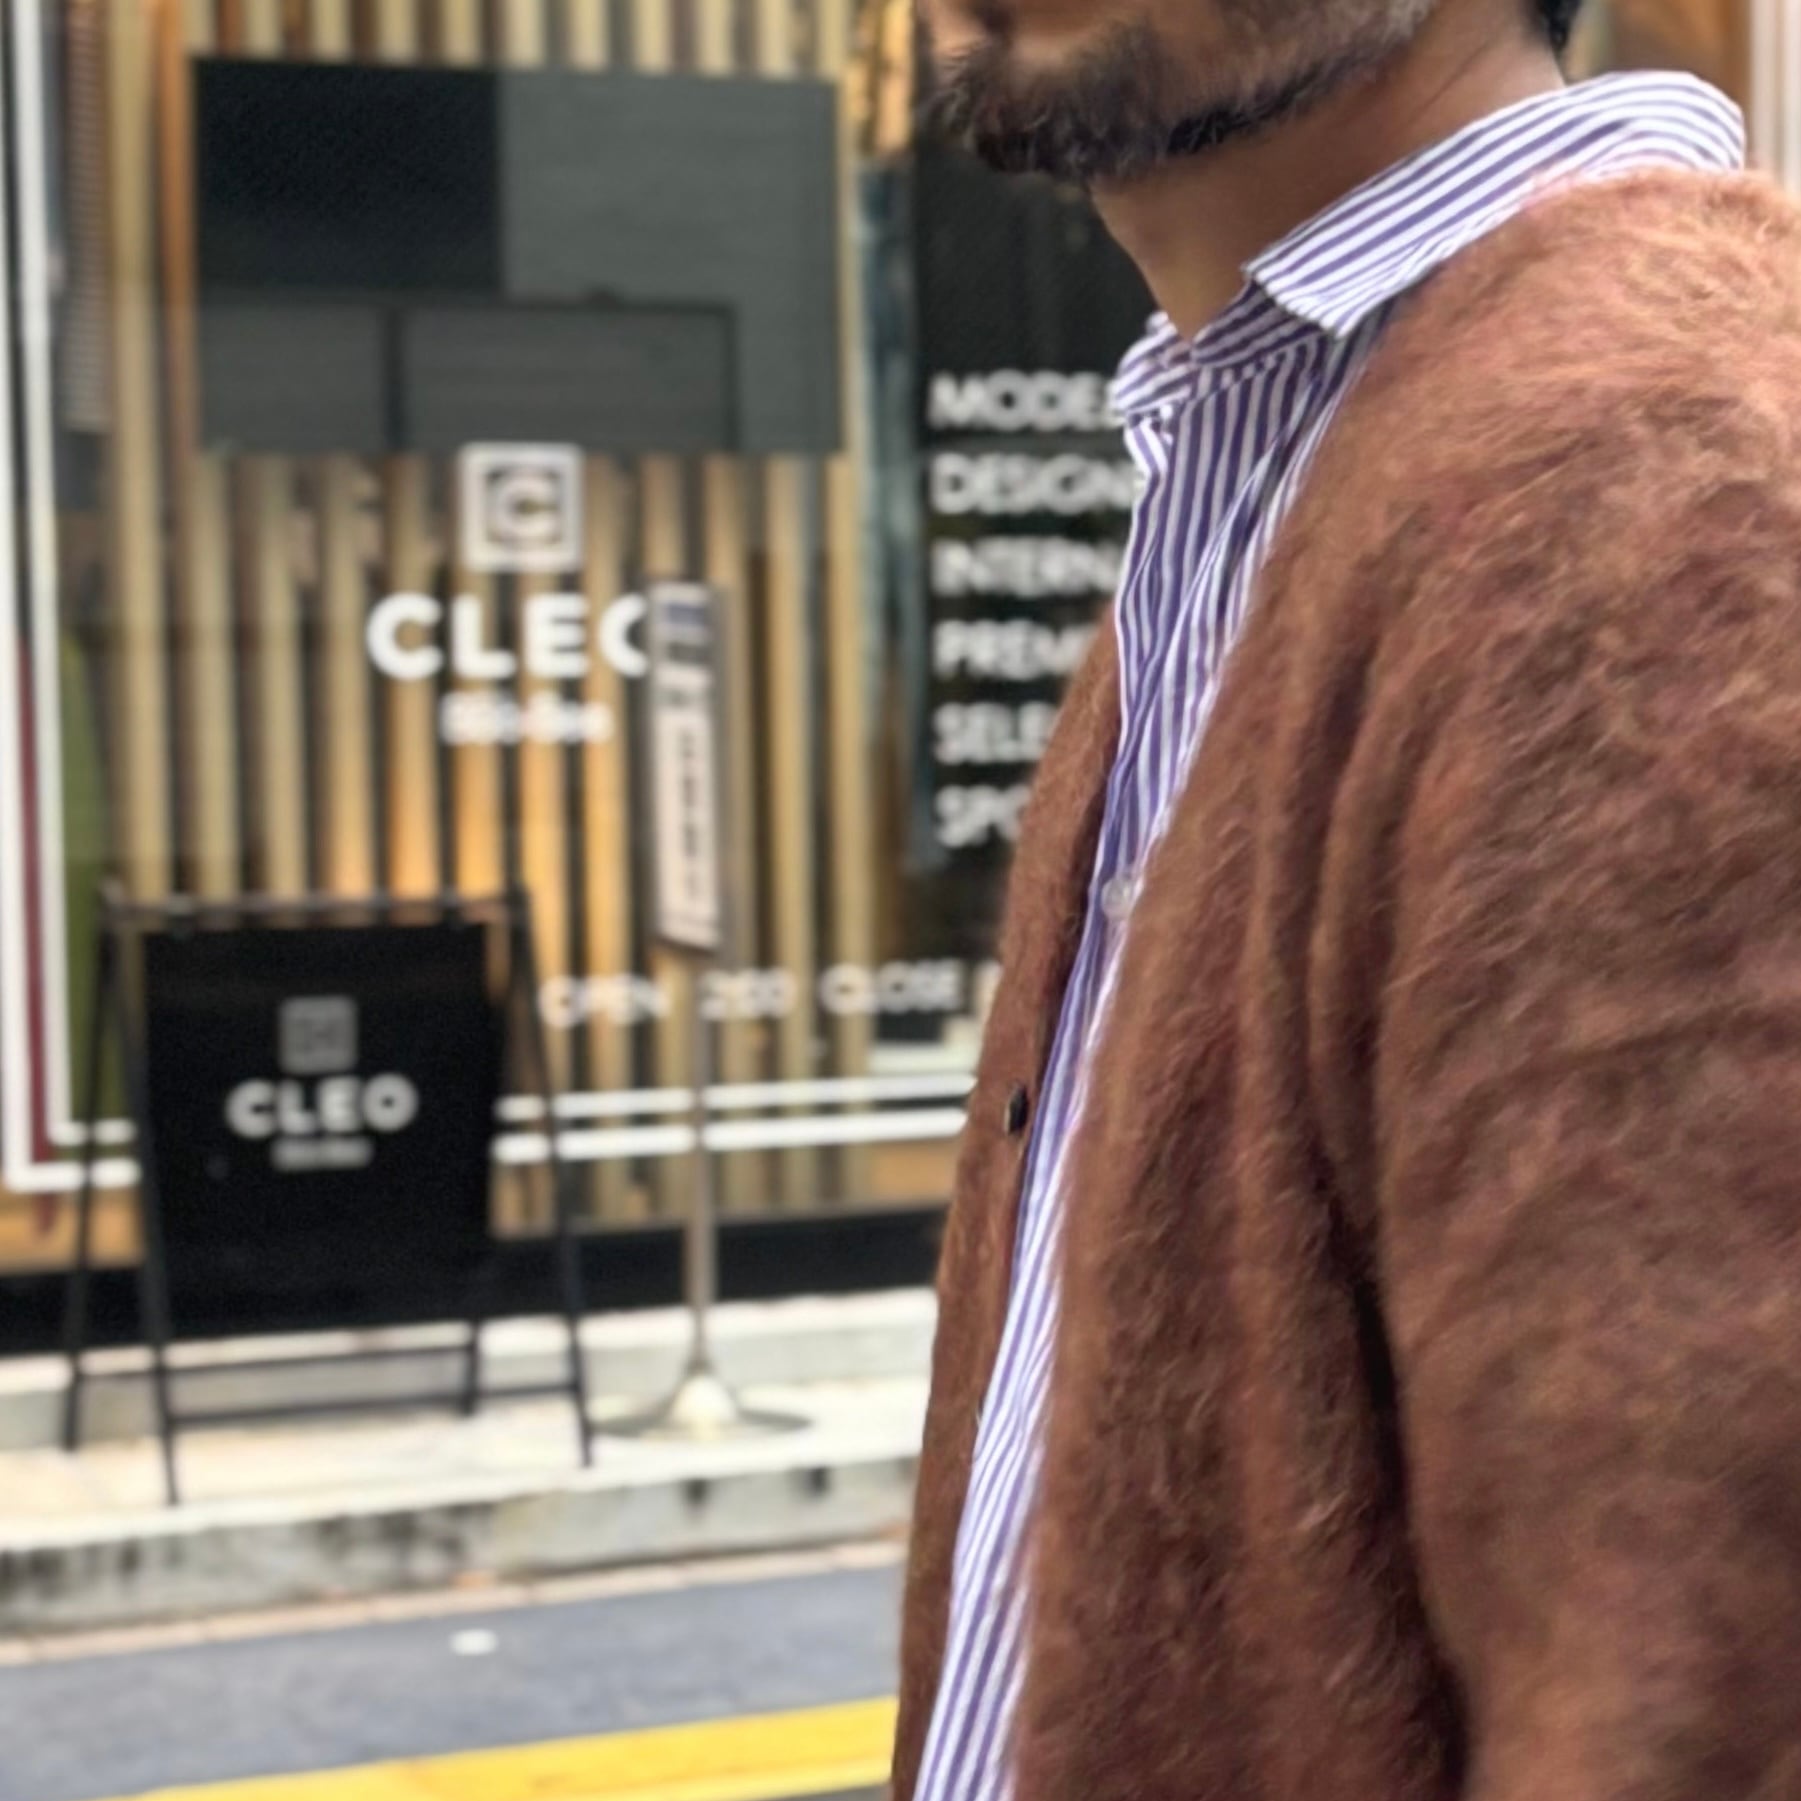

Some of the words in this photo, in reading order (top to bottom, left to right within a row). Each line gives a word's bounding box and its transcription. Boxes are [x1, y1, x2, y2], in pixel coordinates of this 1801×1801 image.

[540, 975, 672, 1029] OPEN
[820, 958, 962, 1016] CLOSE
[225, 1074, 418, 1139] CLEO
